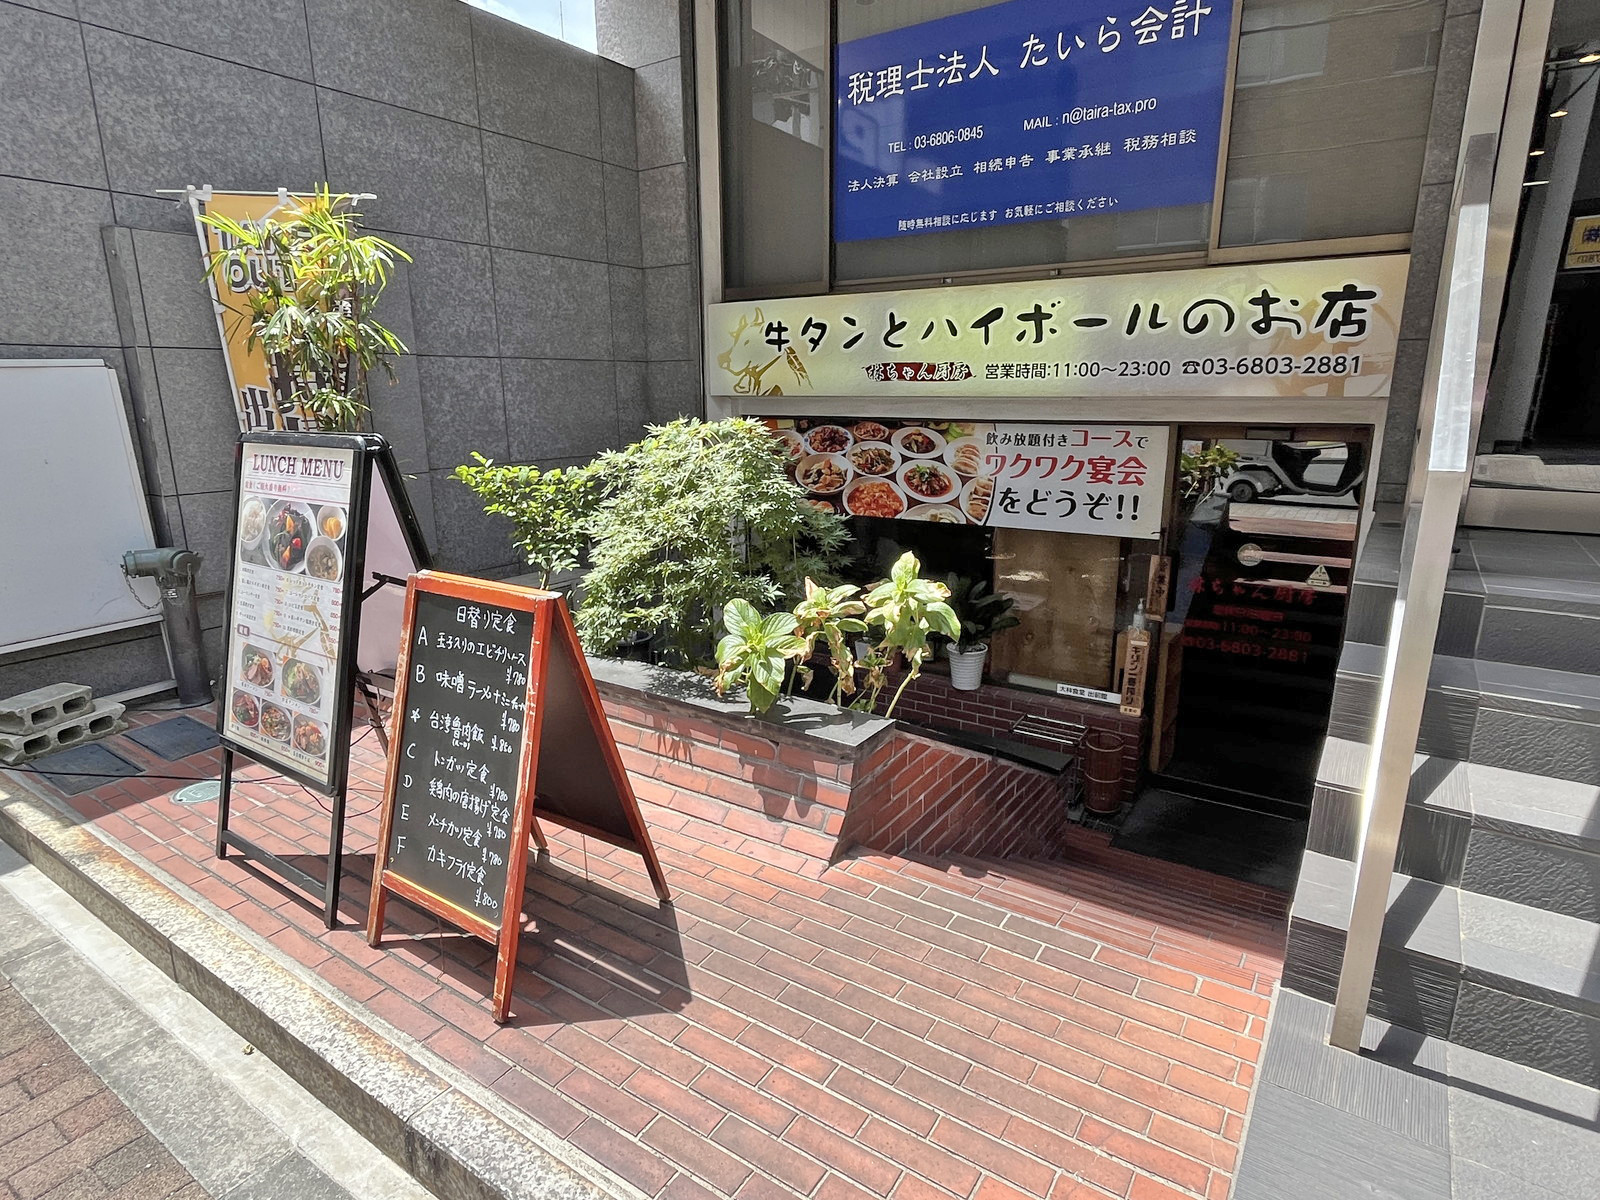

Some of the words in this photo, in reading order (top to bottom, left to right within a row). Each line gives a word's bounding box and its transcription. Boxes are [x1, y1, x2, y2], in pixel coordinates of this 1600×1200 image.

[847, 45, 1000, 106] 税理士法人
[1019, 0, 1212, 69] たいら会計
[1062, 97, 1157, 125] n@taira-tax.pro
[914, 125, 984, 149] 03-6806-0845
[847, 173, 899, 193] 法人決算
[907, 165, 964, 184] 会社設立
[973, 154, 1035, 174] 相続申告
[1045, 141, 1112, 164] 事業承継
[1123, 128, 1197, 153] 税務相談
[1005, 196, 1119, 220] お気軽にご相談ください
[764, 284, 1378, 353] 牛タンとハイボールのお店
[986, 428, 1149, 449] 飲み放題付きコースで
[252, 454, 297, 475] LUNCH
[300, 457, 344, 479] MENU
[985, 453, 1148, 487] ワクワク宴会
[456, 605, 517, 635] 日替り定食
[417, 625, 429, 646] A
[415, 664, 426, 683] B
[406, 743, 417, 759] C
[402, 774, 413, 788] D
[400, 803, 410, 821] E
[396, 835, 407, 854] F
[427, 844, 487, 886] カキフライ定食
